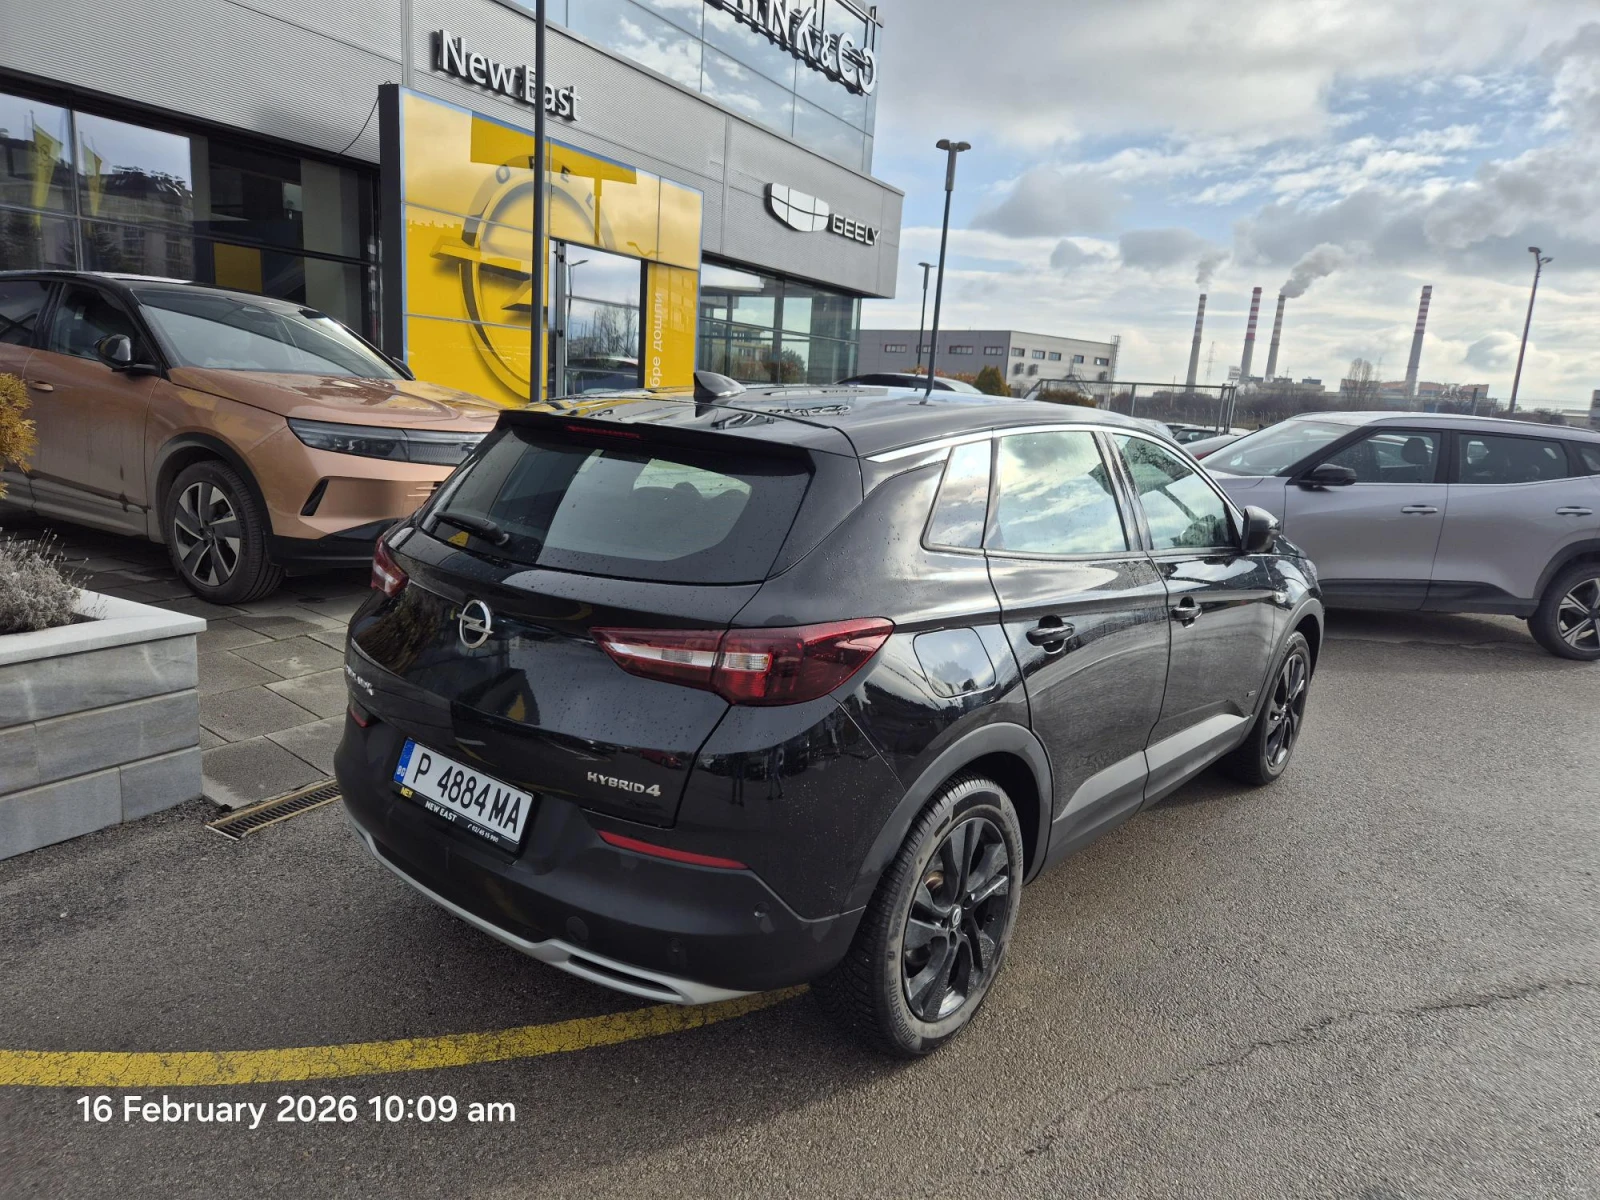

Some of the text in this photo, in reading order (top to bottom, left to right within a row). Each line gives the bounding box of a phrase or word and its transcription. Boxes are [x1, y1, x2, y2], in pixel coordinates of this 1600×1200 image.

[442, 29, 581, 121] New East
[832, 213, 881, 246] GEELY
[413, 752, 432, 784] P
[587, 771, 661, 797] HYBRID4
[425, 801, 457, 822] NEW EAST
